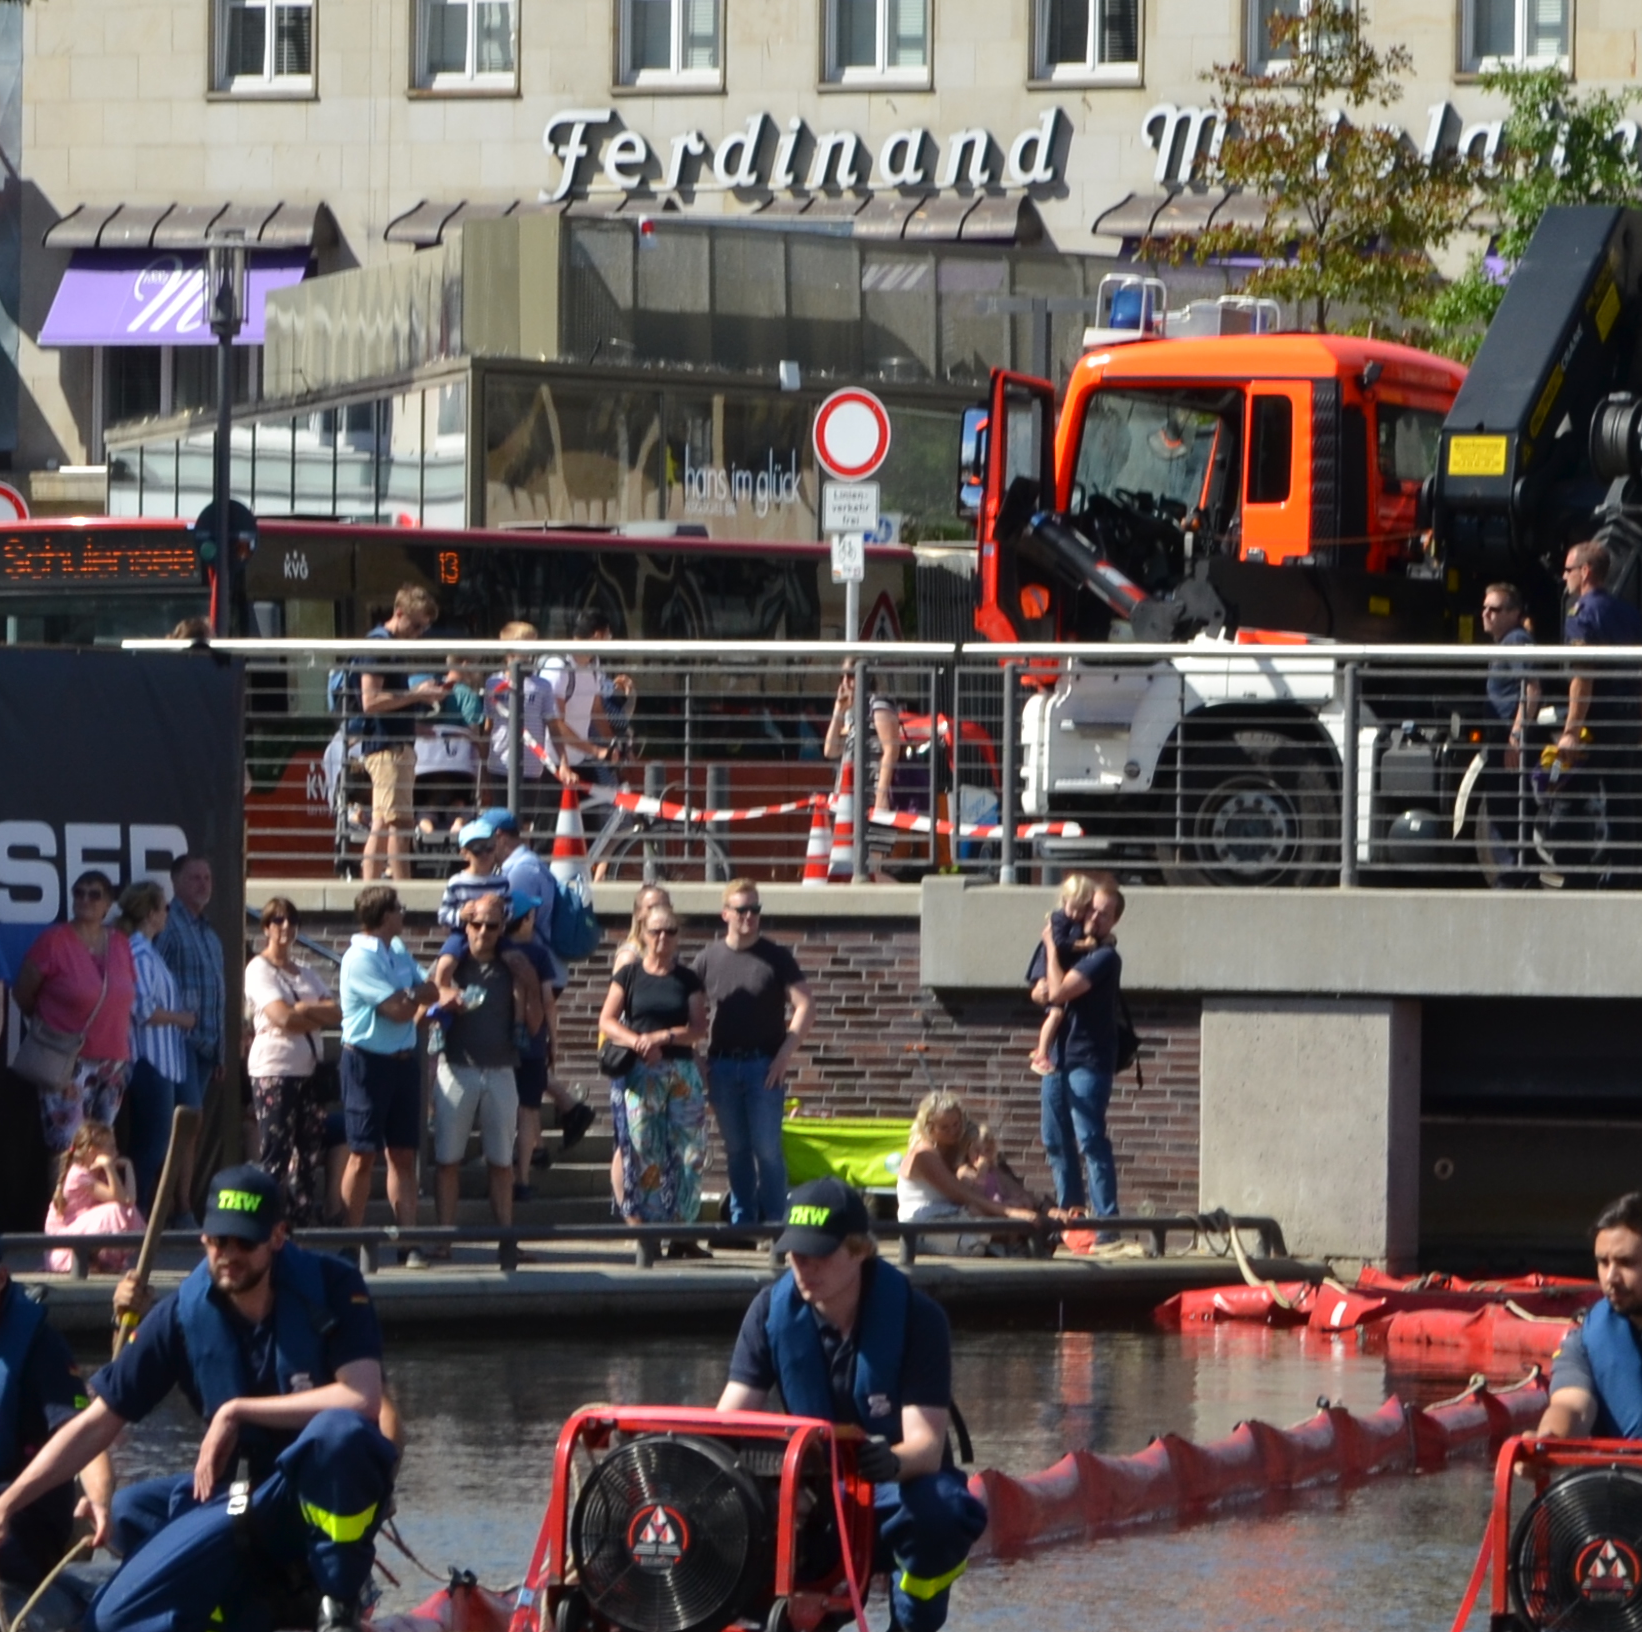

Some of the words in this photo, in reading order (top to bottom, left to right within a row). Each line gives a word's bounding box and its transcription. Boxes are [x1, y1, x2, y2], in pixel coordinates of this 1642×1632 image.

[538, 105, 1060, 203] Ferdinand
[685, 442, 727, 500] hans
[731, 461, 753, 501] im
[756, 446, 802, 518] glück
[439, 552, 460, 584] 13
[218, 1189, 262, 1213] THW
[788, 1204, 831, 1227] THW
